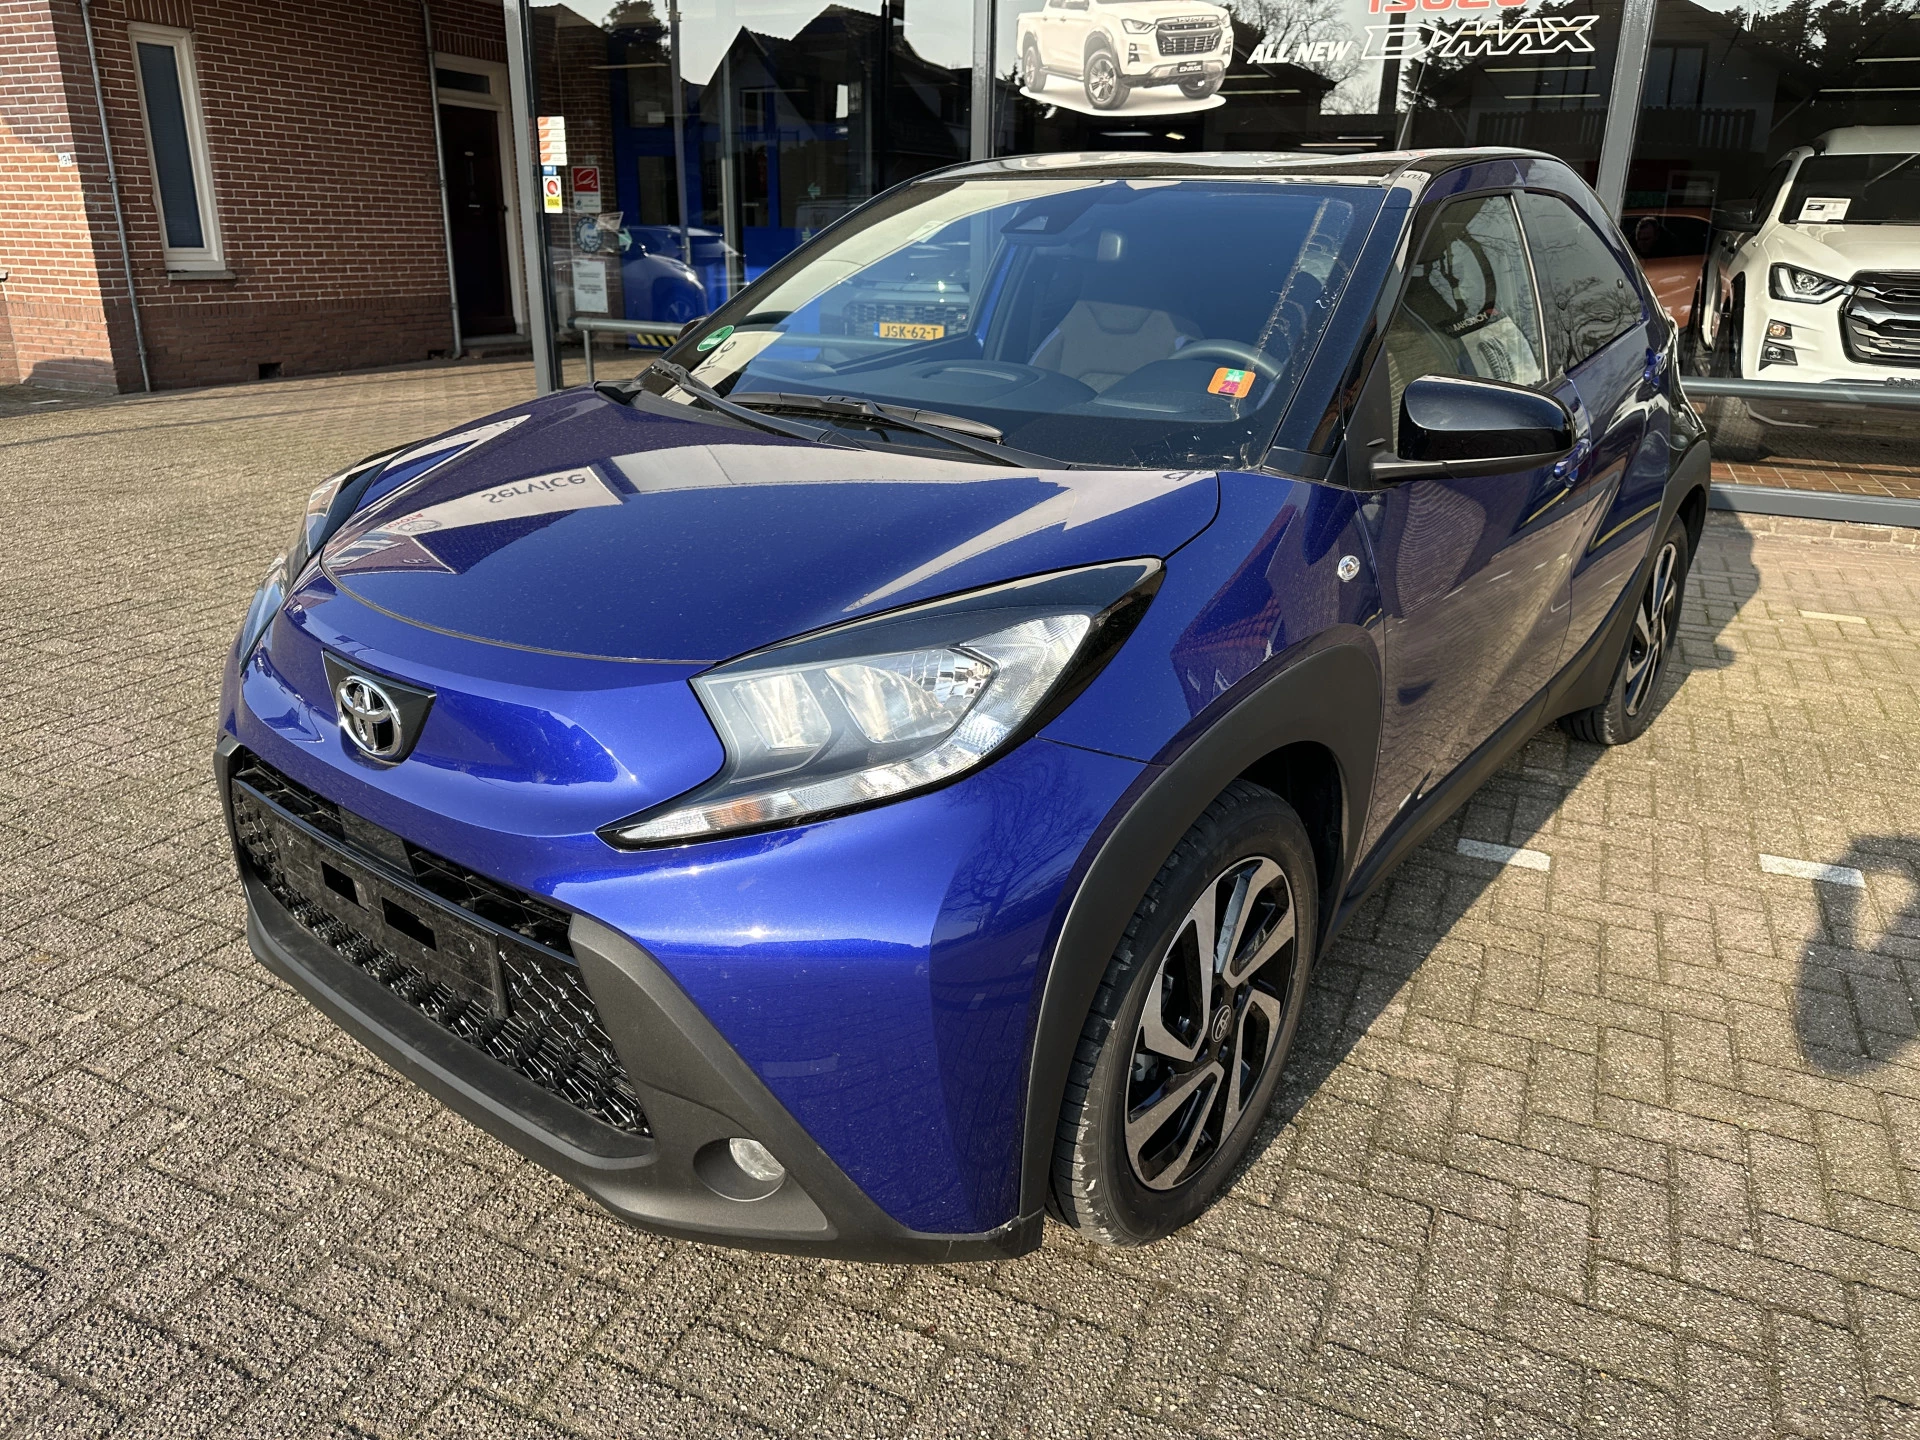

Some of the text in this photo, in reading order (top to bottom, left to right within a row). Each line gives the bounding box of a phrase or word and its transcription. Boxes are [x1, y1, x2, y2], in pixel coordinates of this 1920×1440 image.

[1247, 43, 1290, 64] ALL
[1294, 40, 1354, 63] NEW
[884, 325, 939, 340] JSK-62-T
